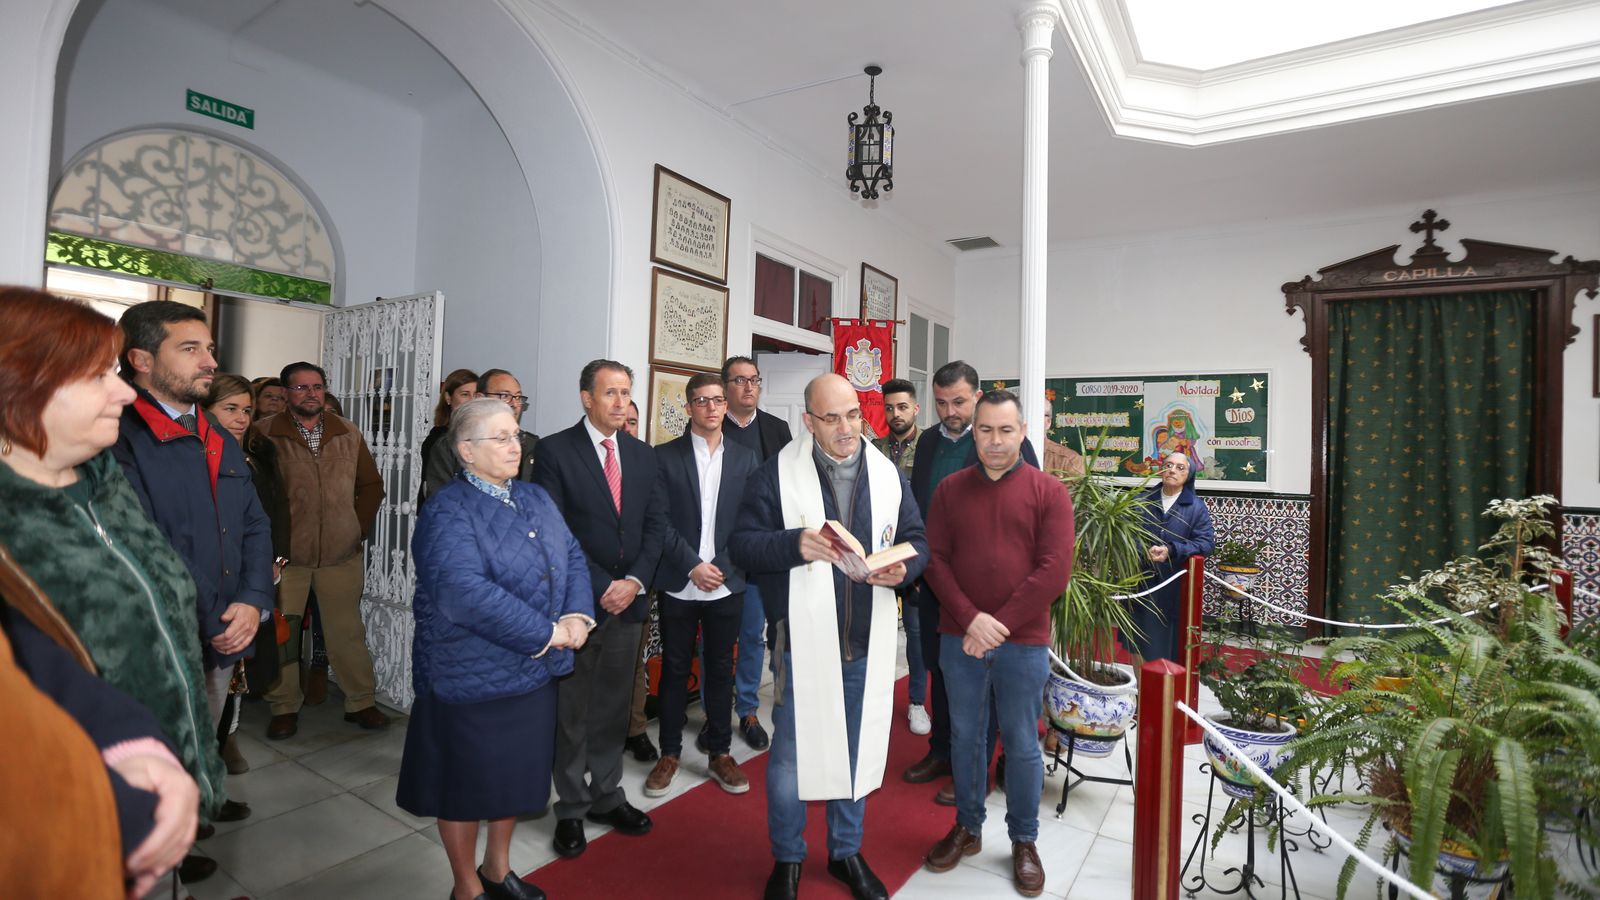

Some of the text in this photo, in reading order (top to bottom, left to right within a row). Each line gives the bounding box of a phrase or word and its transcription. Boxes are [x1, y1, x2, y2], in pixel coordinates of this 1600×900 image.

[191, 95, 247, 125] SALIDA
[1383, 266, 1477, 281] CAPILLA
[1103, 384, 1138, 394] 2019-2020
[1180, 382, 1219, 395] Navidad
